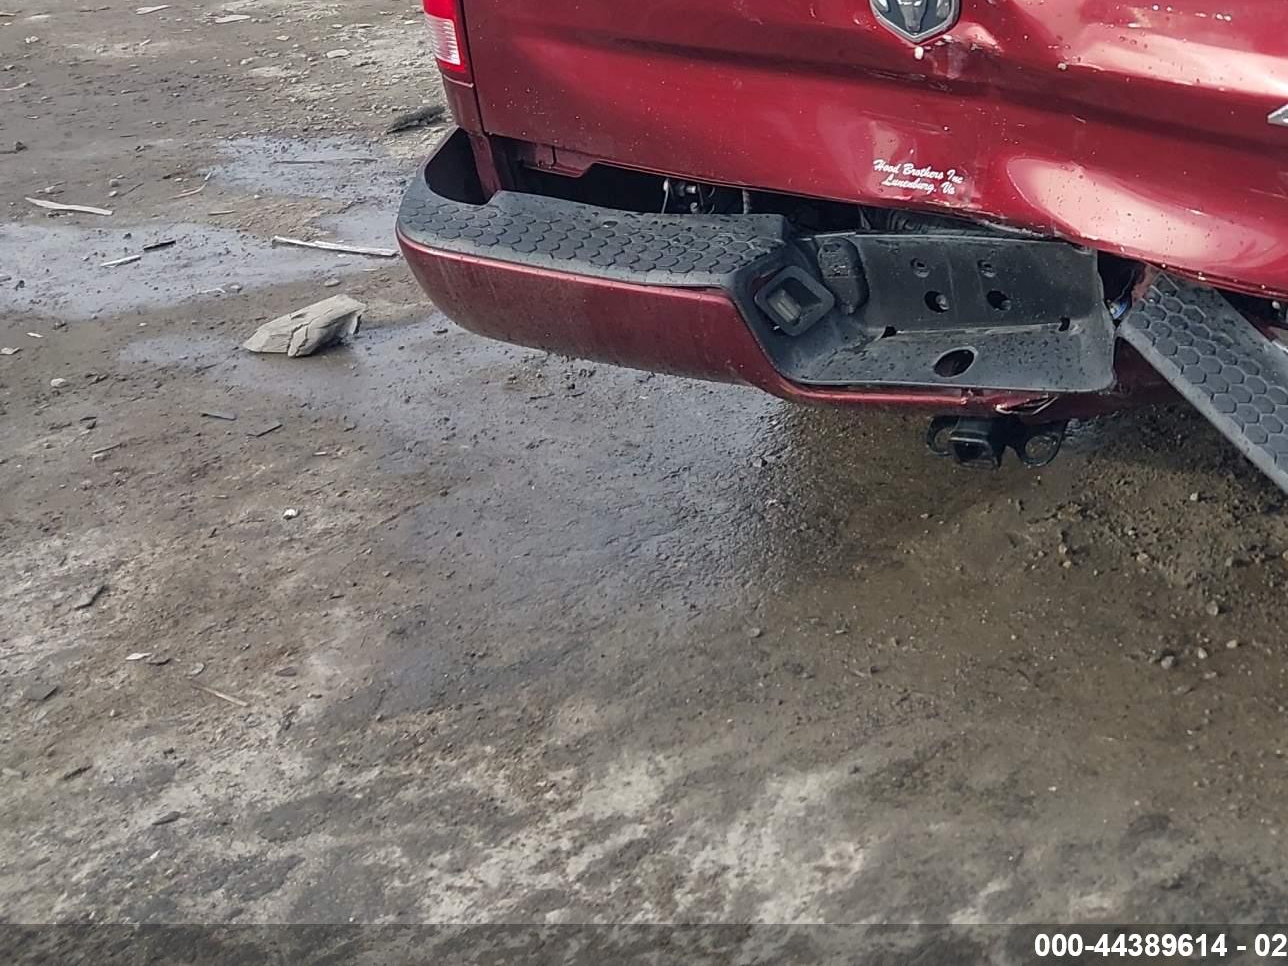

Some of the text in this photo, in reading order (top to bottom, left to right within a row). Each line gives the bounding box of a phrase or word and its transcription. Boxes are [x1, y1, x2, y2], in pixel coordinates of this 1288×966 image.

[873, 159, 964, 184] Hood Brothers Inc
[940, 181, 955, 194] Va
